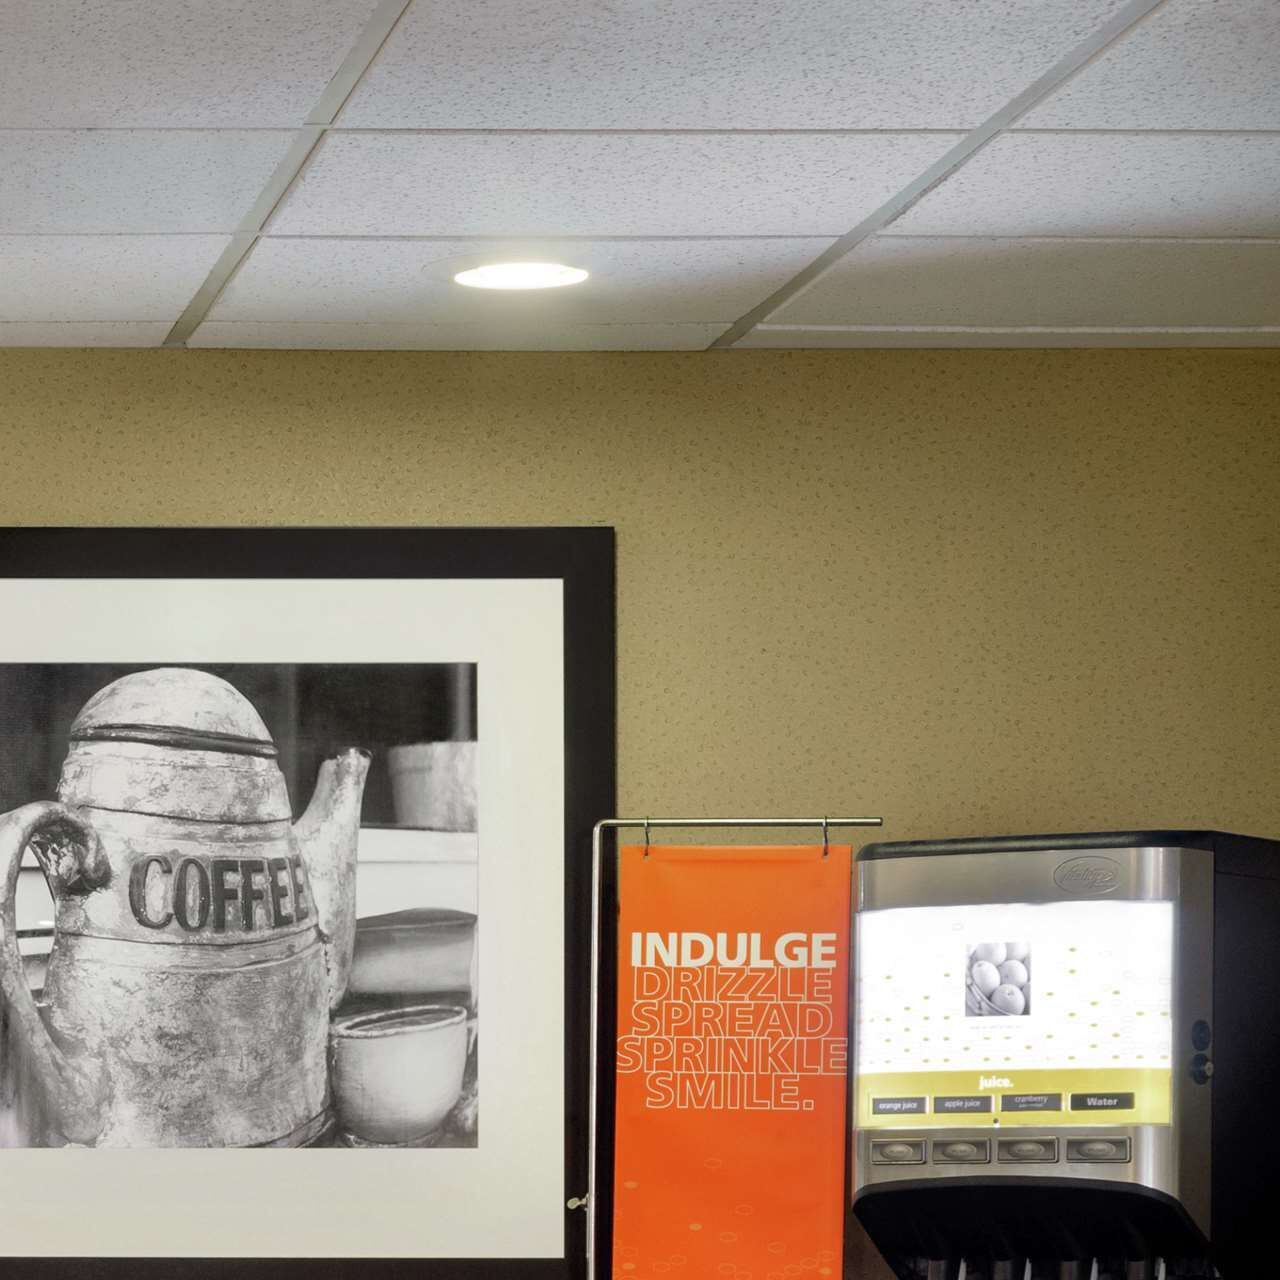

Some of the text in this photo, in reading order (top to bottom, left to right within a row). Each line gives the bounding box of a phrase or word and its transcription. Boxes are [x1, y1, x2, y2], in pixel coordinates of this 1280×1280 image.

[129, 856, 310, 932] COFFEE
[631, 932, 837, 968] INDULGE
[633, 965, 833, 1003] DRIZZLE
[631, 1000, 833, 1040] SPREAD
[616, 1036, 848, 1075] SPRINKLE
[645, 1070, 815, 1111] SMILE.
[978, 1075, 1014, 1090] juice.
[1086, 1097, 1119, 1107] Water
